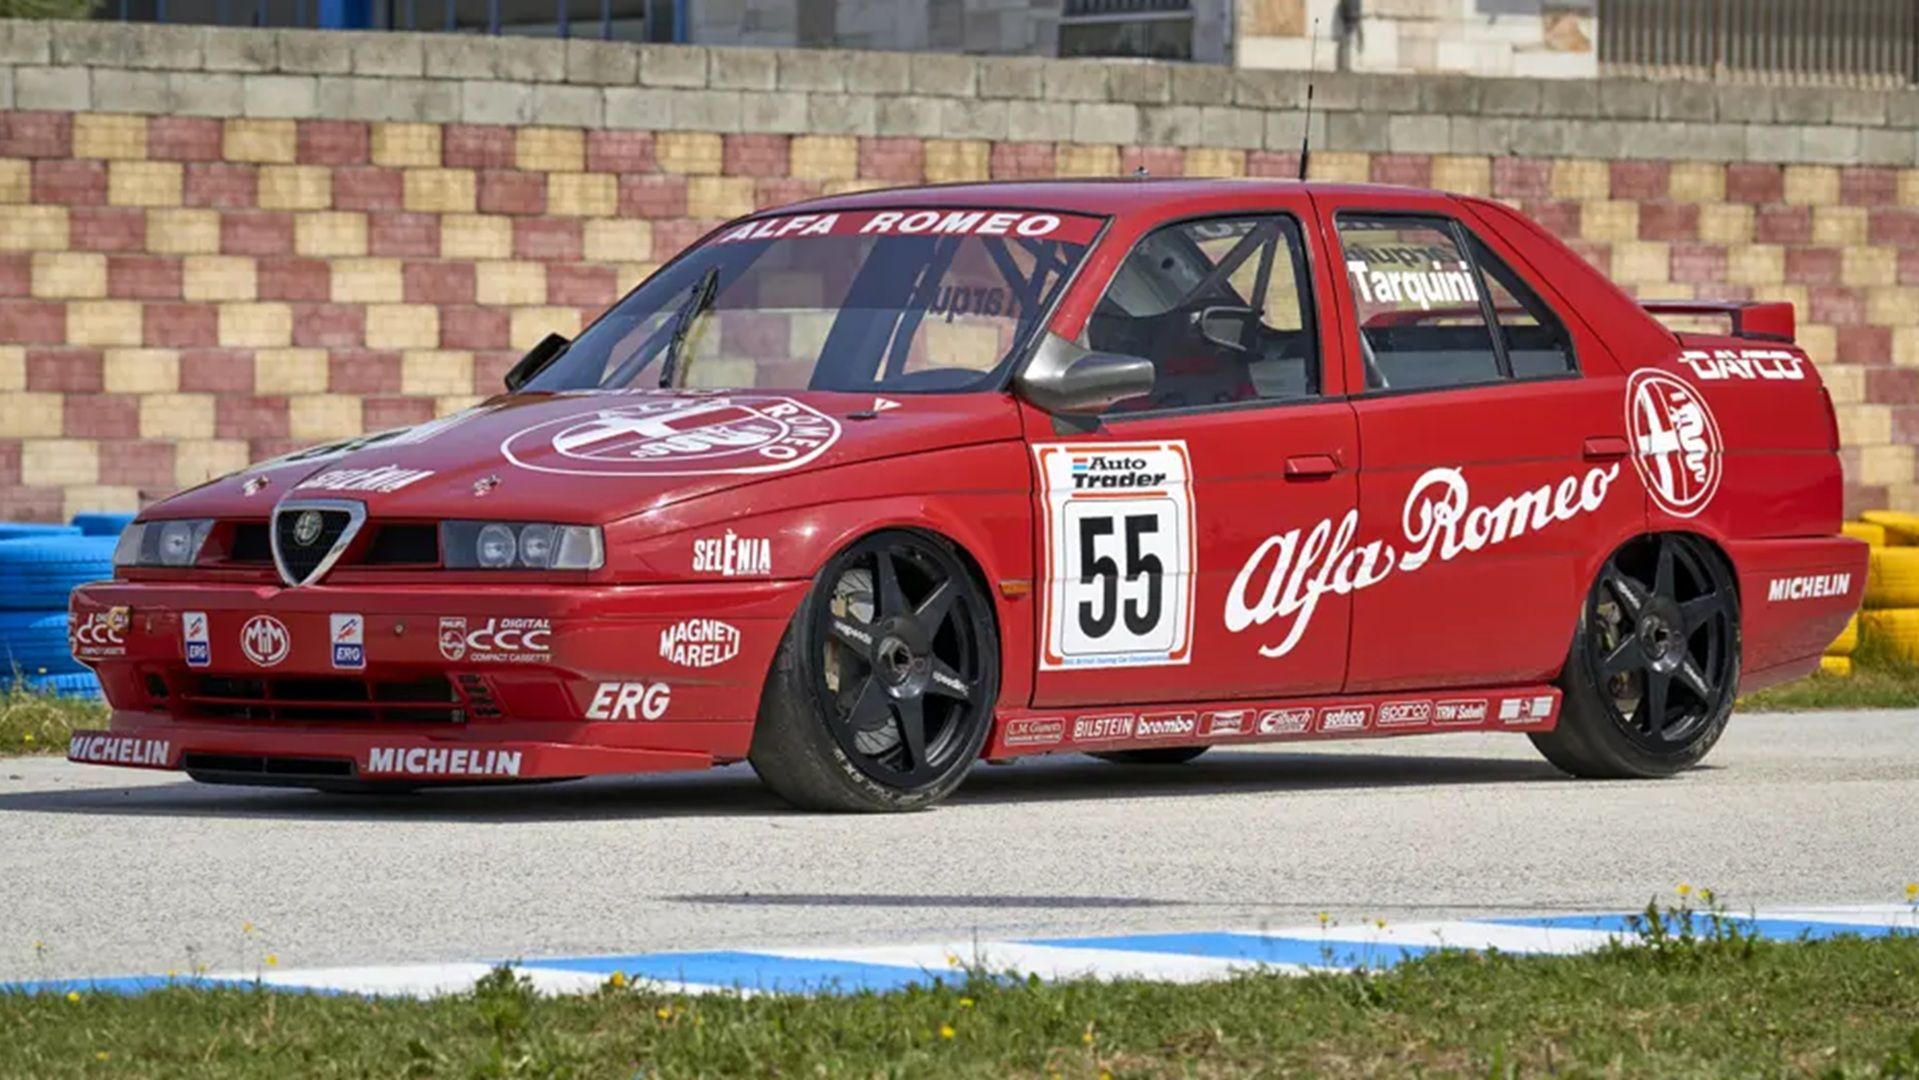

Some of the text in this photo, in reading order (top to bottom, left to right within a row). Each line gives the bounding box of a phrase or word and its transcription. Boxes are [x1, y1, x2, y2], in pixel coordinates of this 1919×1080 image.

[719, 211, 1061, 243] ALFA ROMEO
[1347, 260, 1479, 310] Tarquini
[1678, 350, 1804, 380] DAYCO
[762, 403, 831, 460] ROMEO
[1090, 457, 1147, 471] Auto
[1072, 472, 1166, 489] Trader
[1224, 463, 1620, 658] Alfa Romeo
[1078, 514, 1163, 638] 55
[1768, 573, 1850, 601] MICHELIN
[466, 618, 551, 651] dcc
[500, 619, 550, 629] DIGITAL
[587, 683, 671, 719] ERG
[1381, 705, 1430, 719] sparco
[1074, 718, 1133, 738] BILSTEIN
[1137, 715, 1194, 735] brembo
[71, 737, 169, 764] MICHELIN
[368, 747, 522, 776] MICHELIN
